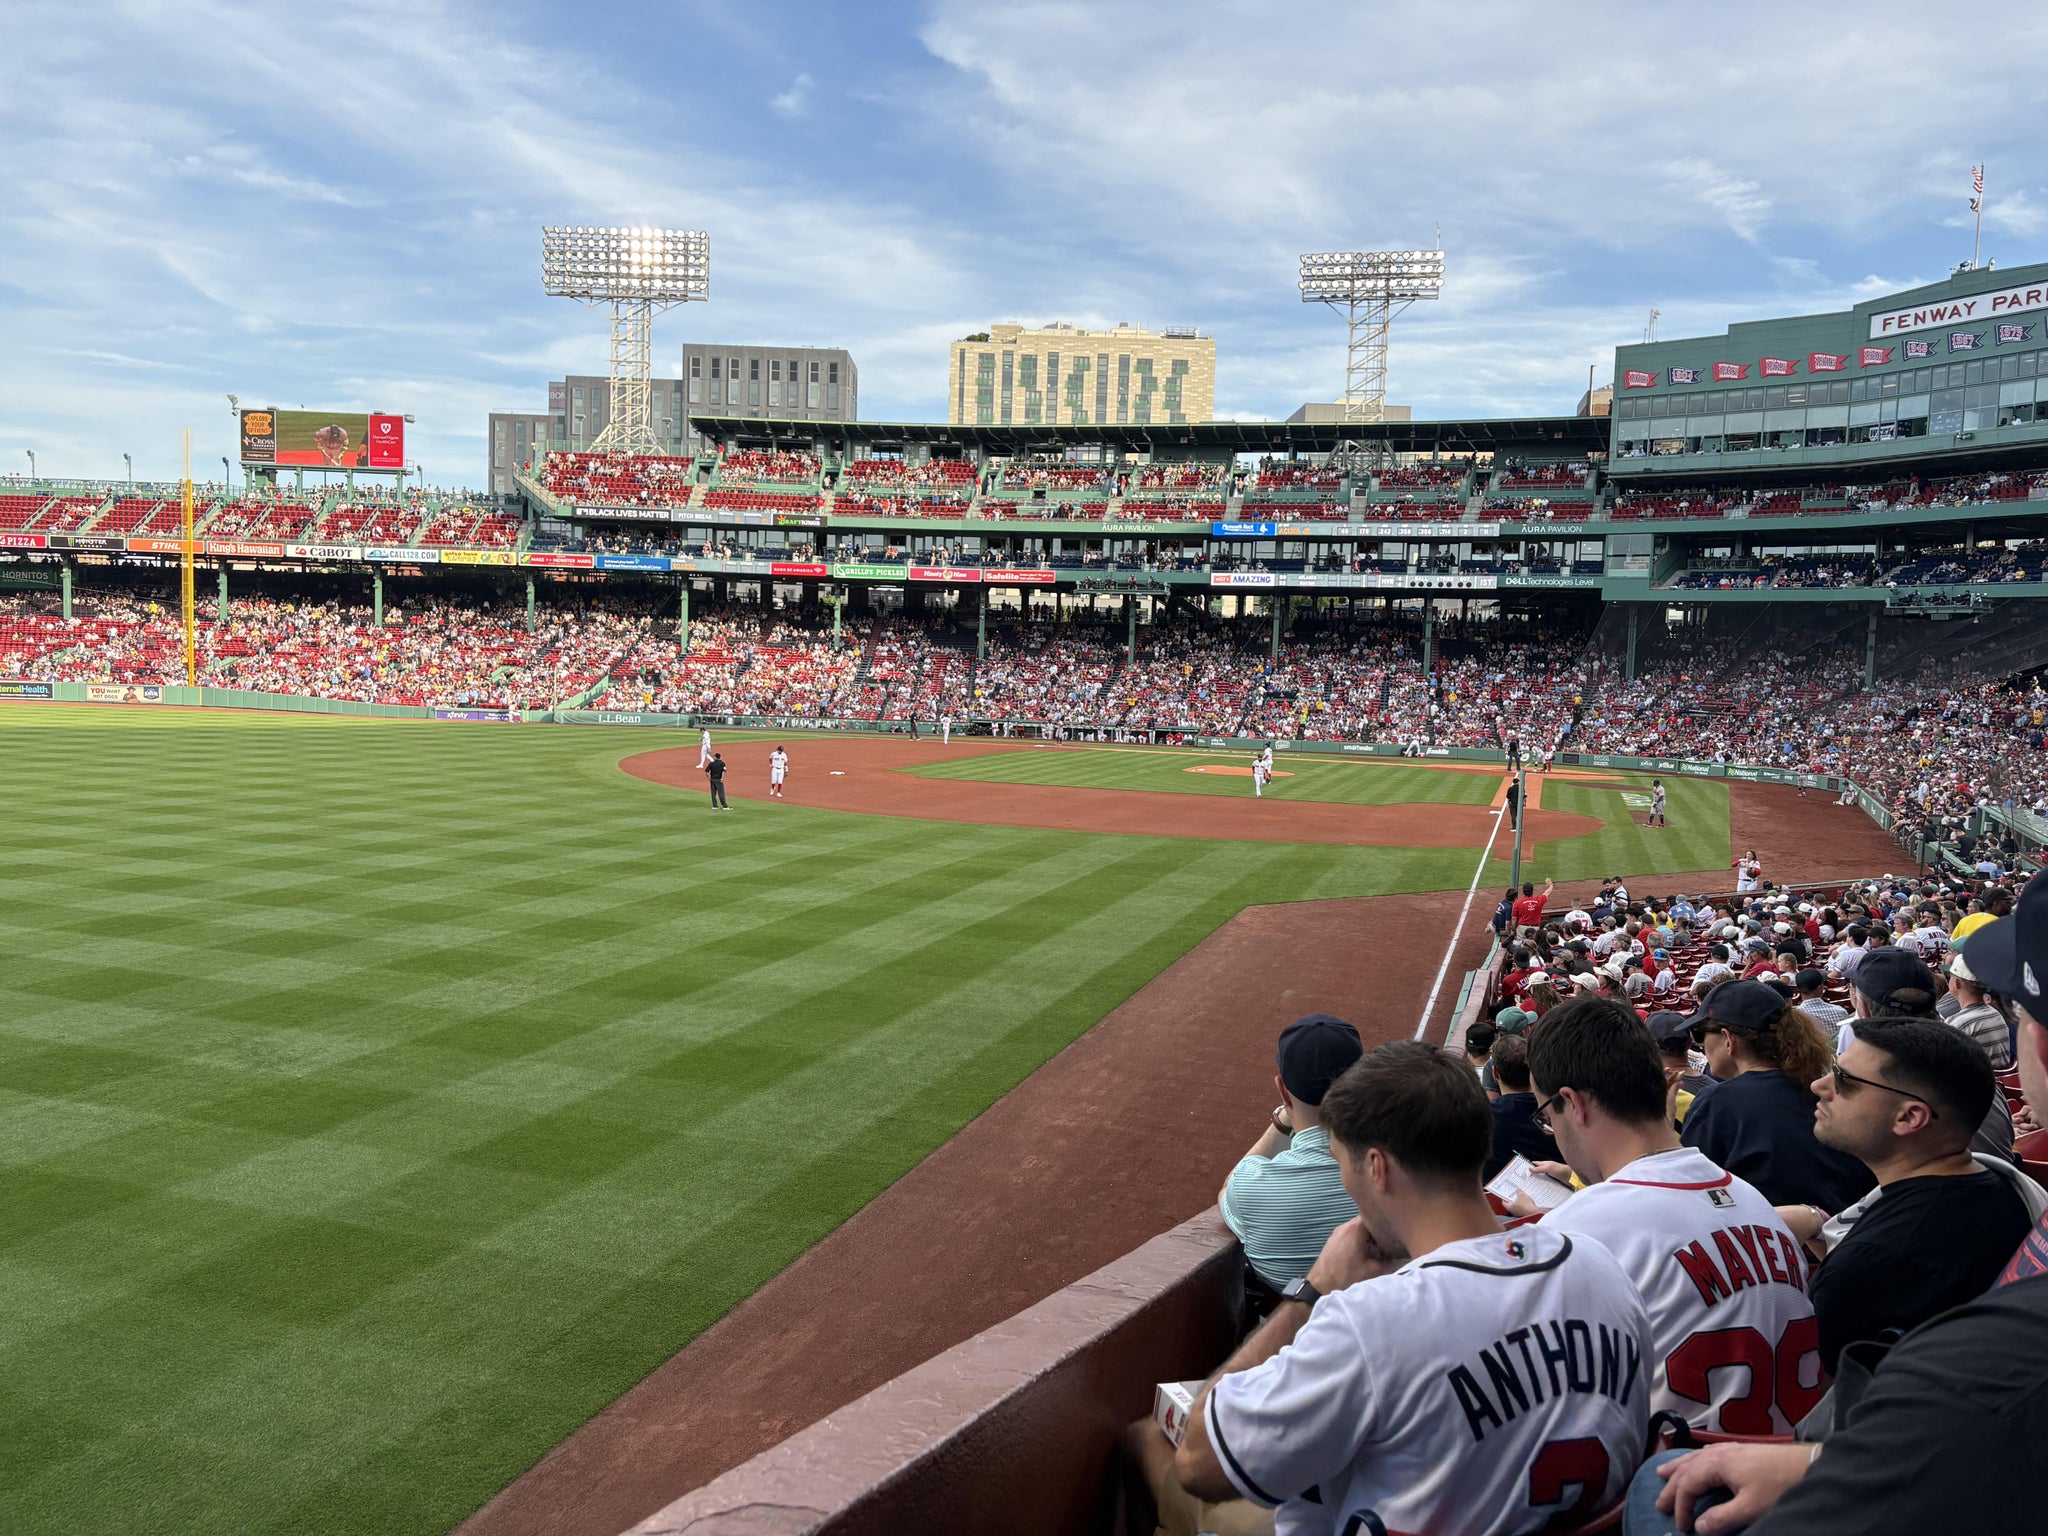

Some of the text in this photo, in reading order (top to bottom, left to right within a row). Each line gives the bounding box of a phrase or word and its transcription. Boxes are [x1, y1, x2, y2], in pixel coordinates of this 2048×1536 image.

[1882, 287, 2048, 331] FENWAY PAR
[2000, 327, 2023, 338] 1975
[639, 511, 669, 519] MATTER
[7, 537, 36, 546] PIZZA
[151, 541, 181, 550] STIHL
[209, 542, 280, 555] King's Hawaiian
[2, 571, 49, 580] HORNITOS
[845, 568, 874, 576] GRILLO'S
[923, 570, 942, 578] Ninety
[986, 572, 1020, 580] Safelite
[1232, 575, 1271, 584] AMAZING
[1505, 577, 1527, 585] DELL
[1528, 577, 1573, 587] Technologies
[1426, 747, 1450, 755] Franklin
[1687, 764, 1709, 772] National
[1673, 1224, 1804, 1308] MAYER
[1448, 1319, 1640, 1441] ANTHONY
